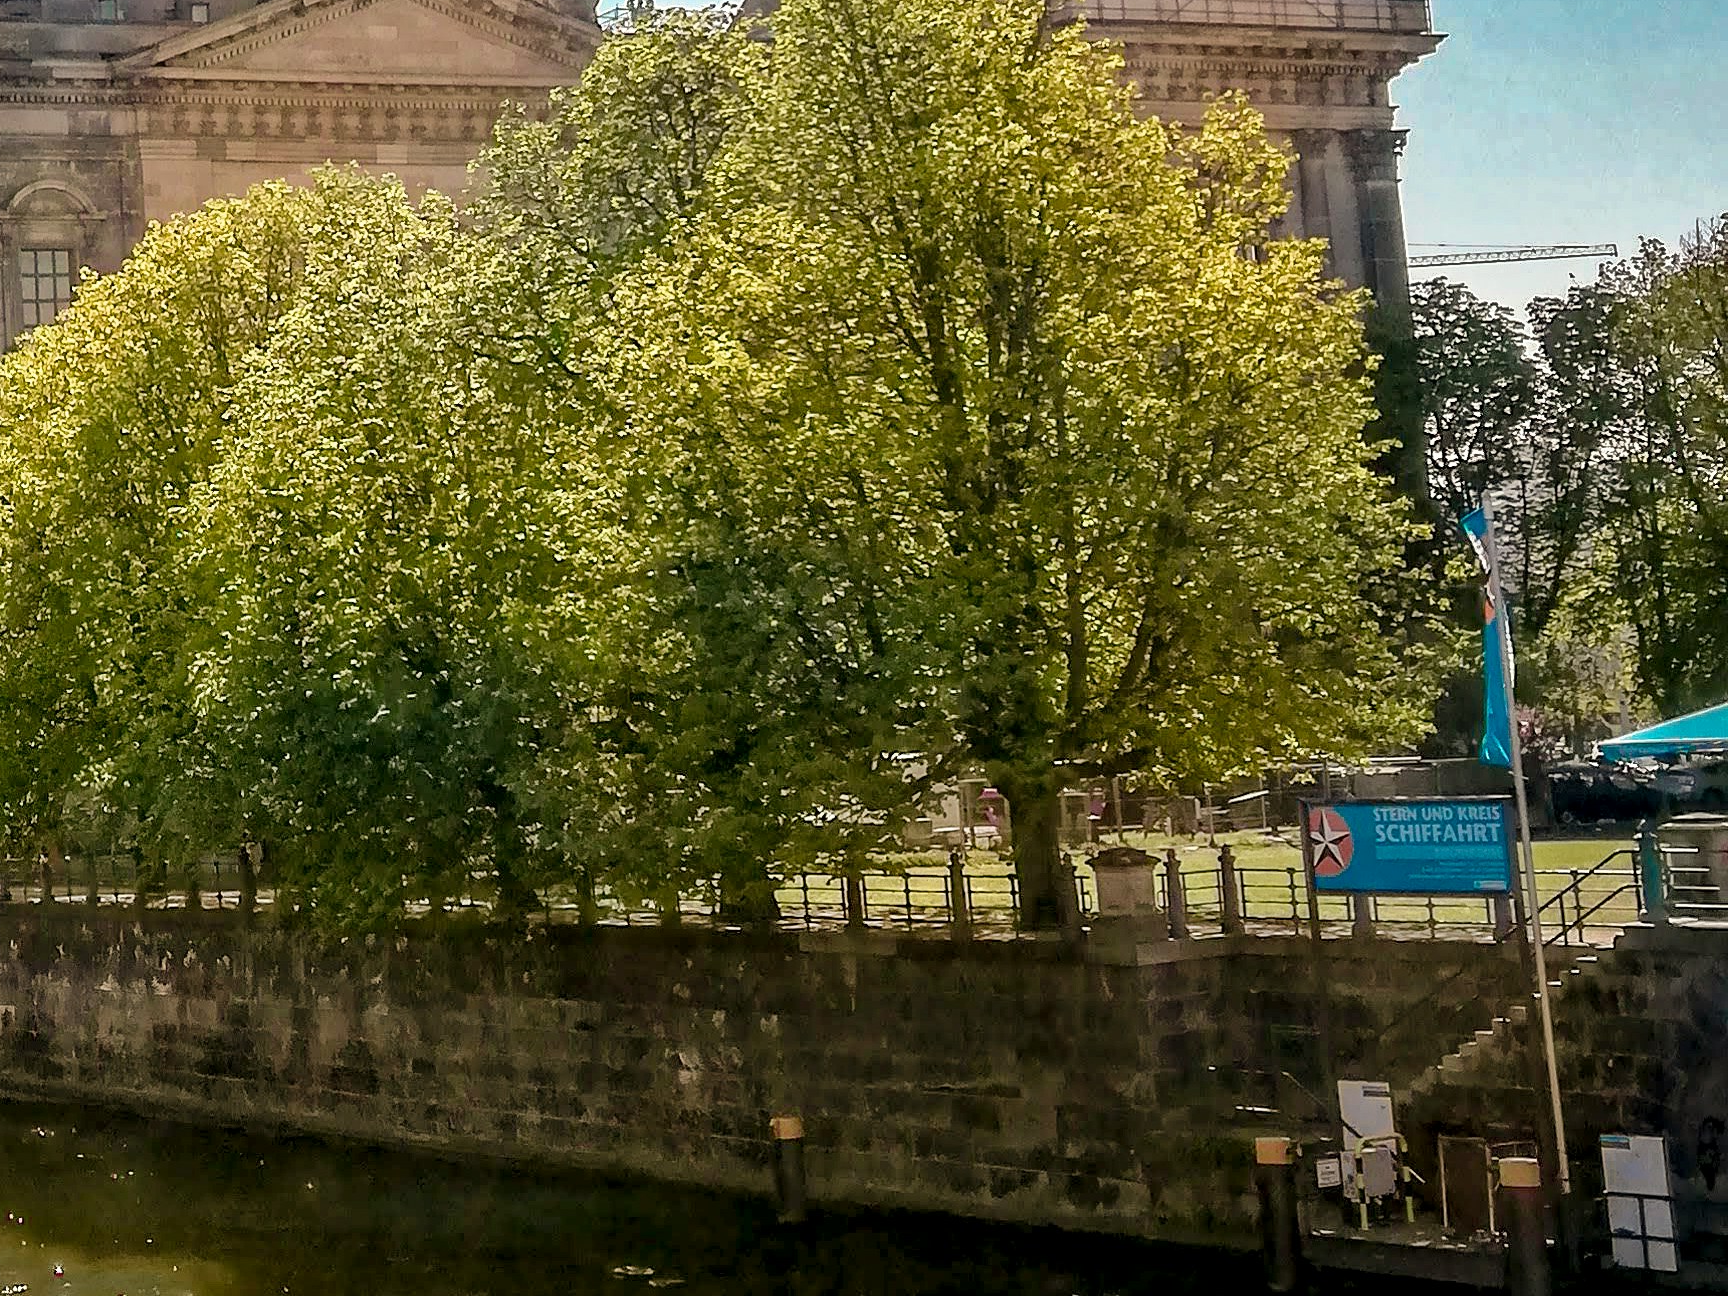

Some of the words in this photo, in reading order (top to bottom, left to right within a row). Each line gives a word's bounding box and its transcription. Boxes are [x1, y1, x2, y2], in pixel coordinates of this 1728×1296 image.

[1373, 806, 1417, 822] STERN
[1421, 806, 1453, 821] UND
[1457, 805, 1501, 821] KREIS
[1375, 822, 1501, 843] SCHIFFAHRT
